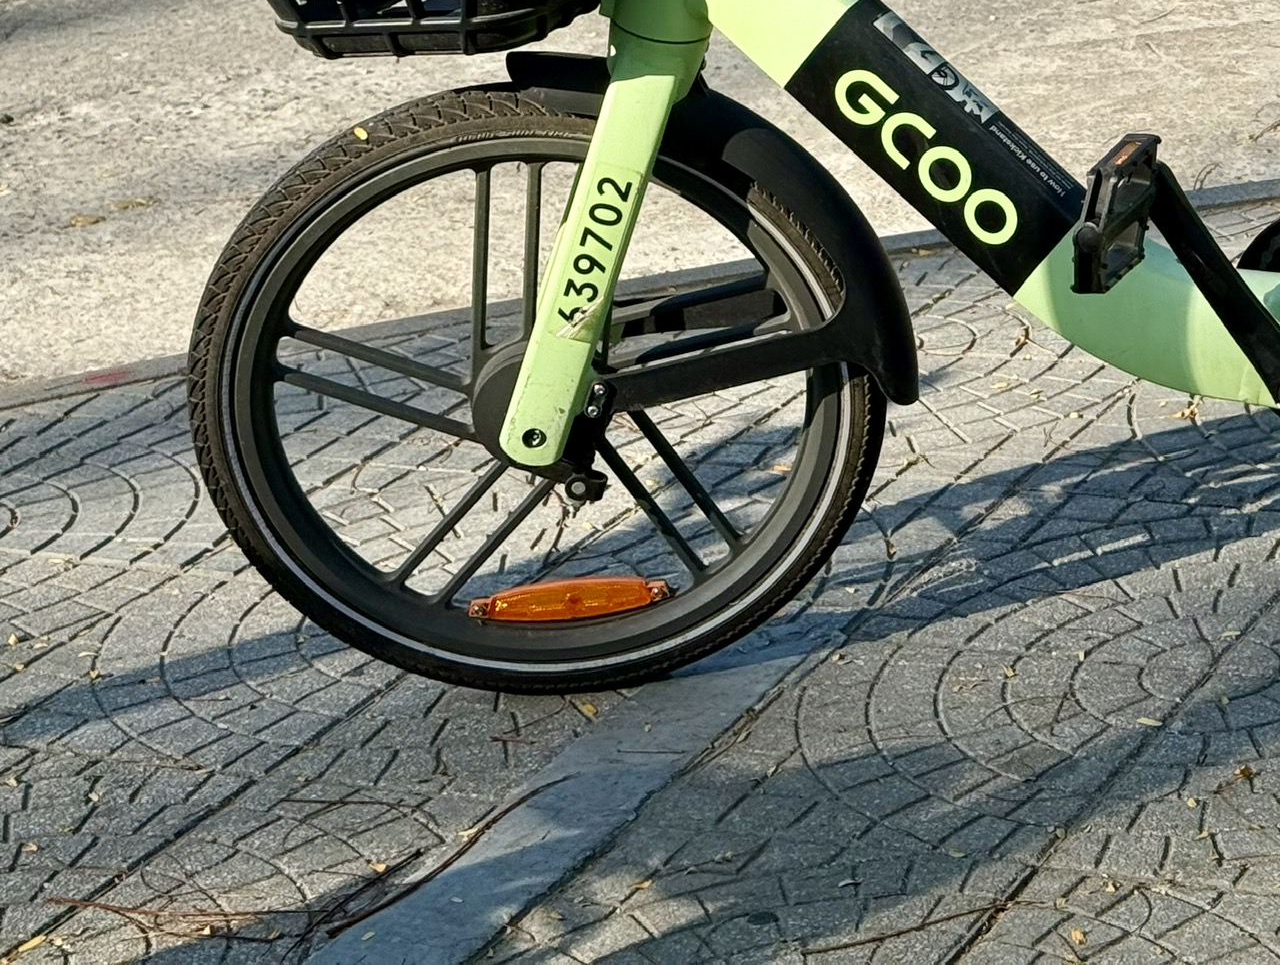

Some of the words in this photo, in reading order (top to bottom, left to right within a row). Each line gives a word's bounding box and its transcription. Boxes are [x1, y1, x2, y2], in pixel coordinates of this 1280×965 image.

[988, 125, 1028, 161] Kickstand
[834, 69, 1018, 245] GCOO
[1025, 158, 1041, 173] use
[1039, 171, 1049, 181] to
[1047, 179, 1066, 198] How
